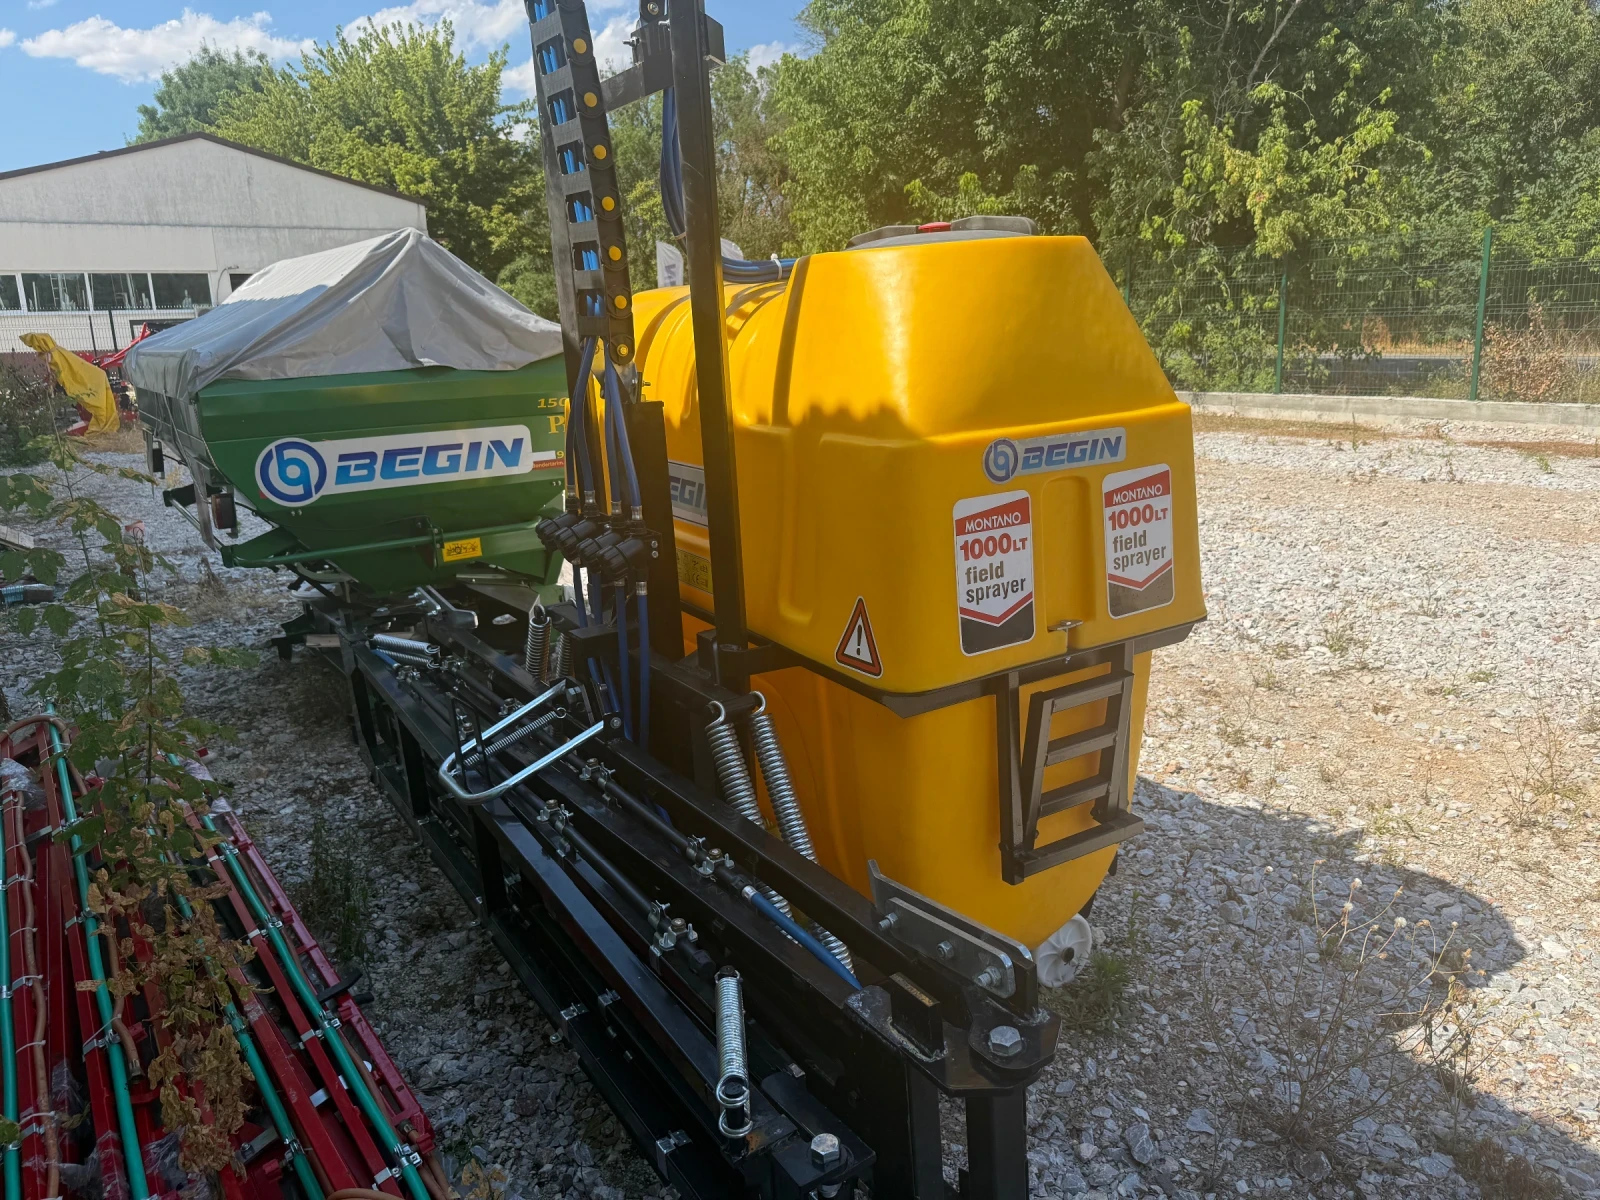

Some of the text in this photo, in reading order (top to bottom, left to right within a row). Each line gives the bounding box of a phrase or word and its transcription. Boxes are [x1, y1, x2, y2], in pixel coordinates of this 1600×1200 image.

[335, 437, 524, 486] BEGIN
[1021, 435, 1123, 470] BEGIN
[669, 475, 708, 510] EGI
[1112, 483, 1163, 505] MONTANO
[965, 511, 1022, 533] MONTANO
[1108, 503, 1168, 531] 1000LT
[960, 532, 1028, 561] 1000LT
[1112, 530, 1147, 554] field
[1113, 545, 1167, 572] sprayer
[965, 561, 1005, 585] field
[966, 578, 1026, 605] sprayer
